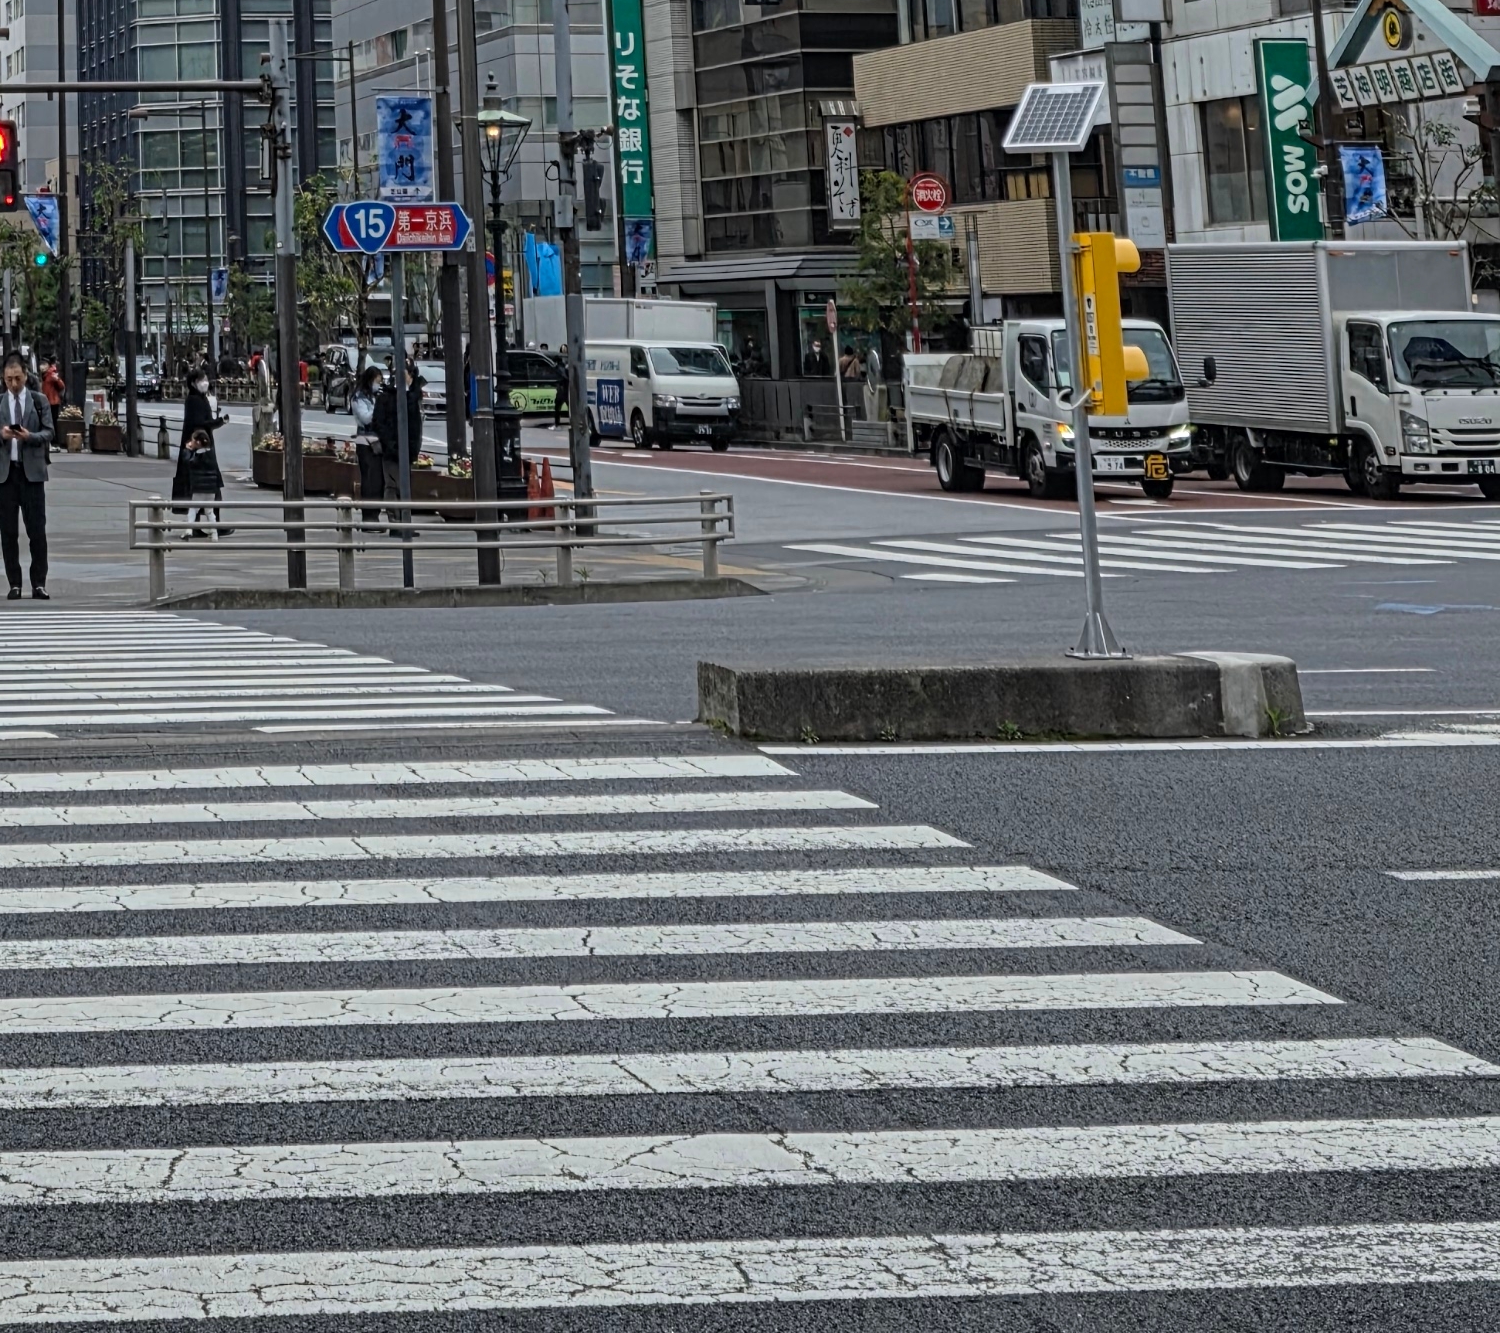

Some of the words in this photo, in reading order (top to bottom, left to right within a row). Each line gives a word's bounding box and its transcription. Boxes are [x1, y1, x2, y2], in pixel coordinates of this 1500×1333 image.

[615, 32, 644, 184] りそな銀行
[1282, 145, 1310, 215] MOS
[916, 188, 943, 202] 消火栓
[354, 208, 386, 239] 15
[398, 210, 453, 232] 第一京浜
[1098, 430, 1159, 438] FUSO
[1146, 454, 1168, 480] 危
